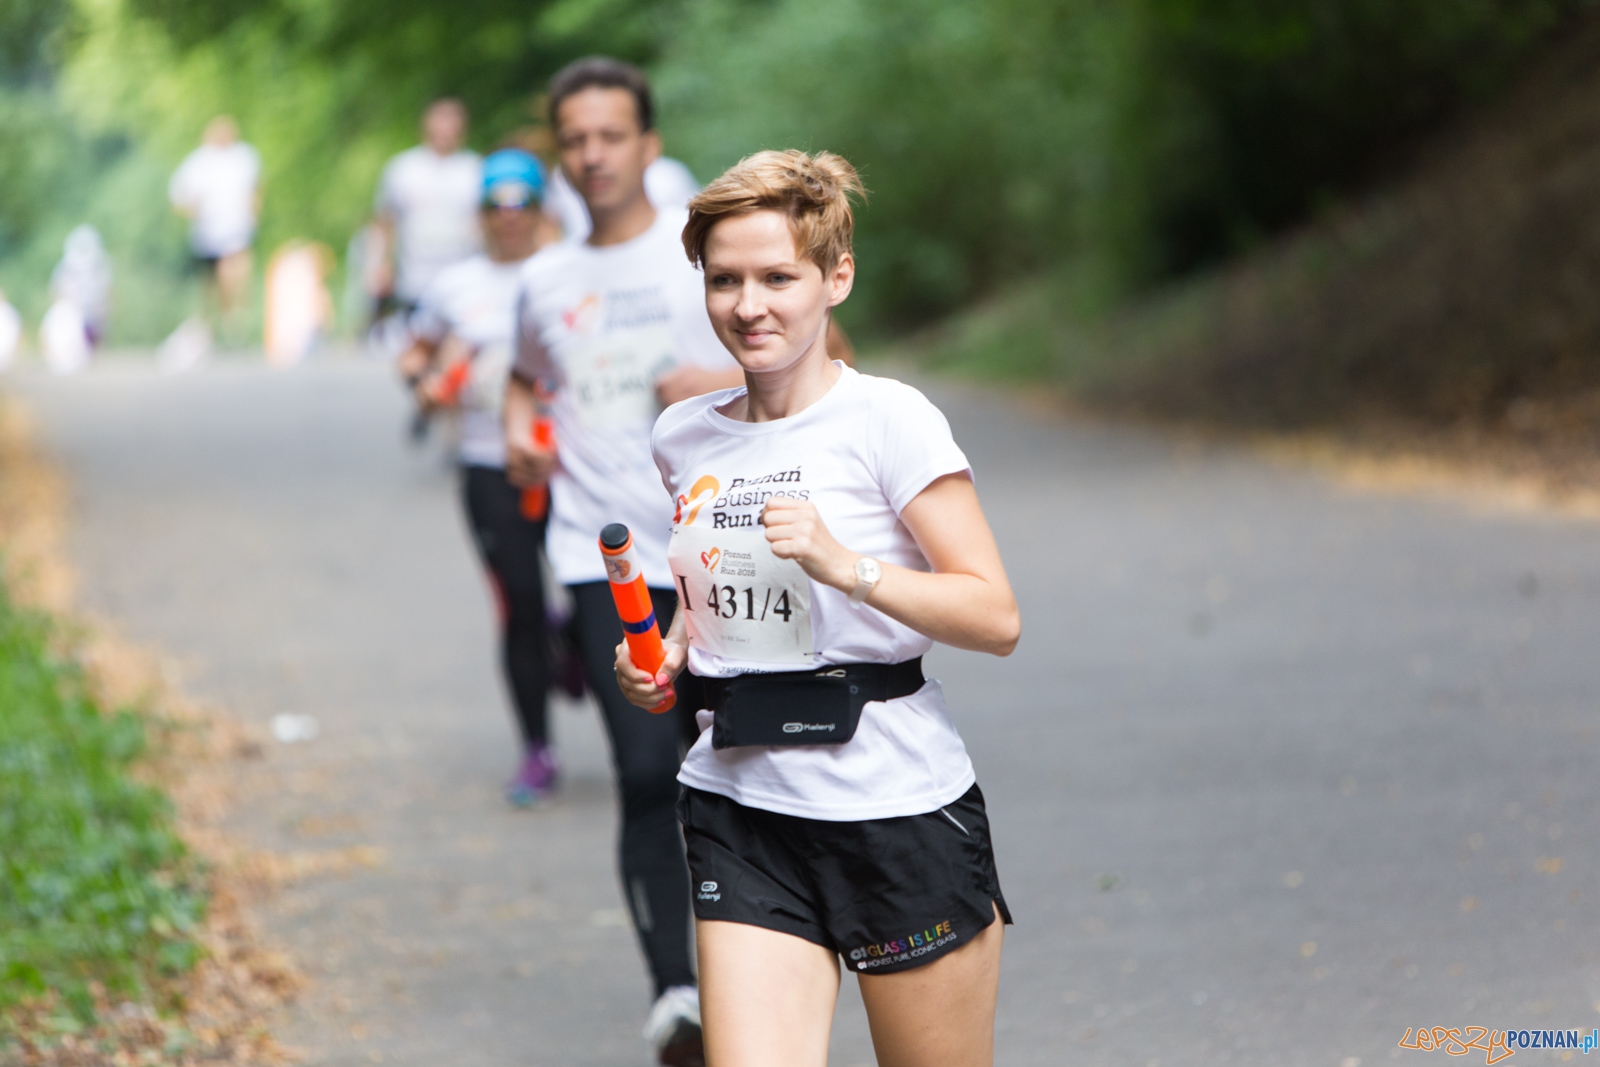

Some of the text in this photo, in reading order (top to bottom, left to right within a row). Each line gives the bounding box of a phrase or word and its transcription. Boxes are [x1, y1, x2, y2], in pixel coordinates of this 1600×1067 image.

[712, 511, 753, 529] Run
[720, 566, 736, 576] Run
[676, 574, 695, 611] I
[707, 583, 792, 622] 431/4
[867, 939, 907, 957] GLASS
[908, 933, 923, 948] IS
[924, 920, 952, 942] LIFE
[910, 942, 937, 958] ICONIC
[936, 932, 957, 947] GLASS
